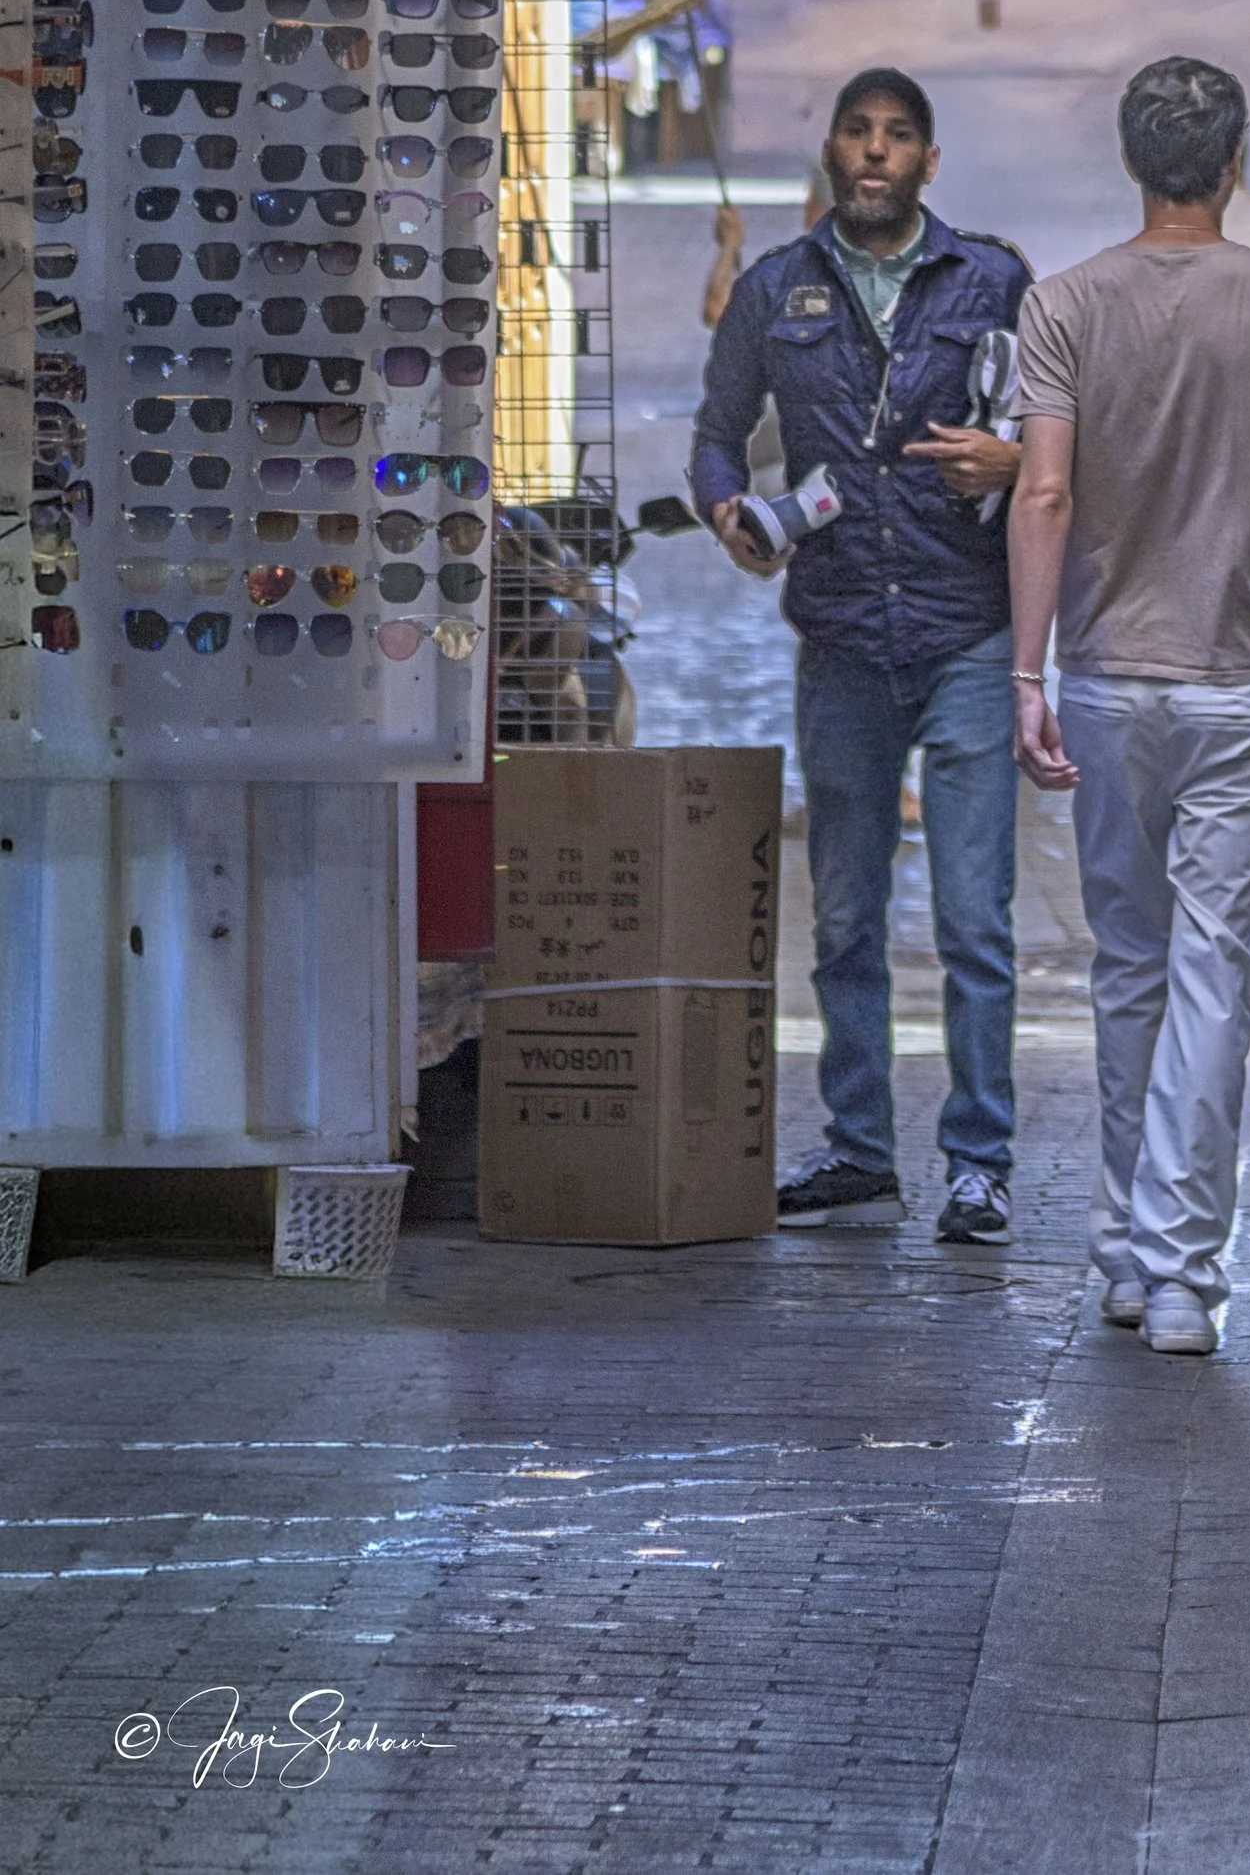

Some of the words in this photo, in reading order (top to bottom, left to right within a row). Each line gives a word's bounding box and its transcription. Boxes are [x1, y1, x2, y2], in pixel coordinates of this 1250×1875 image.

[508, 847, 528, 862] KG
[744, 830, 771, 1158] LUGBONA
[519, 1047, 634, 1072] LUGBONA
